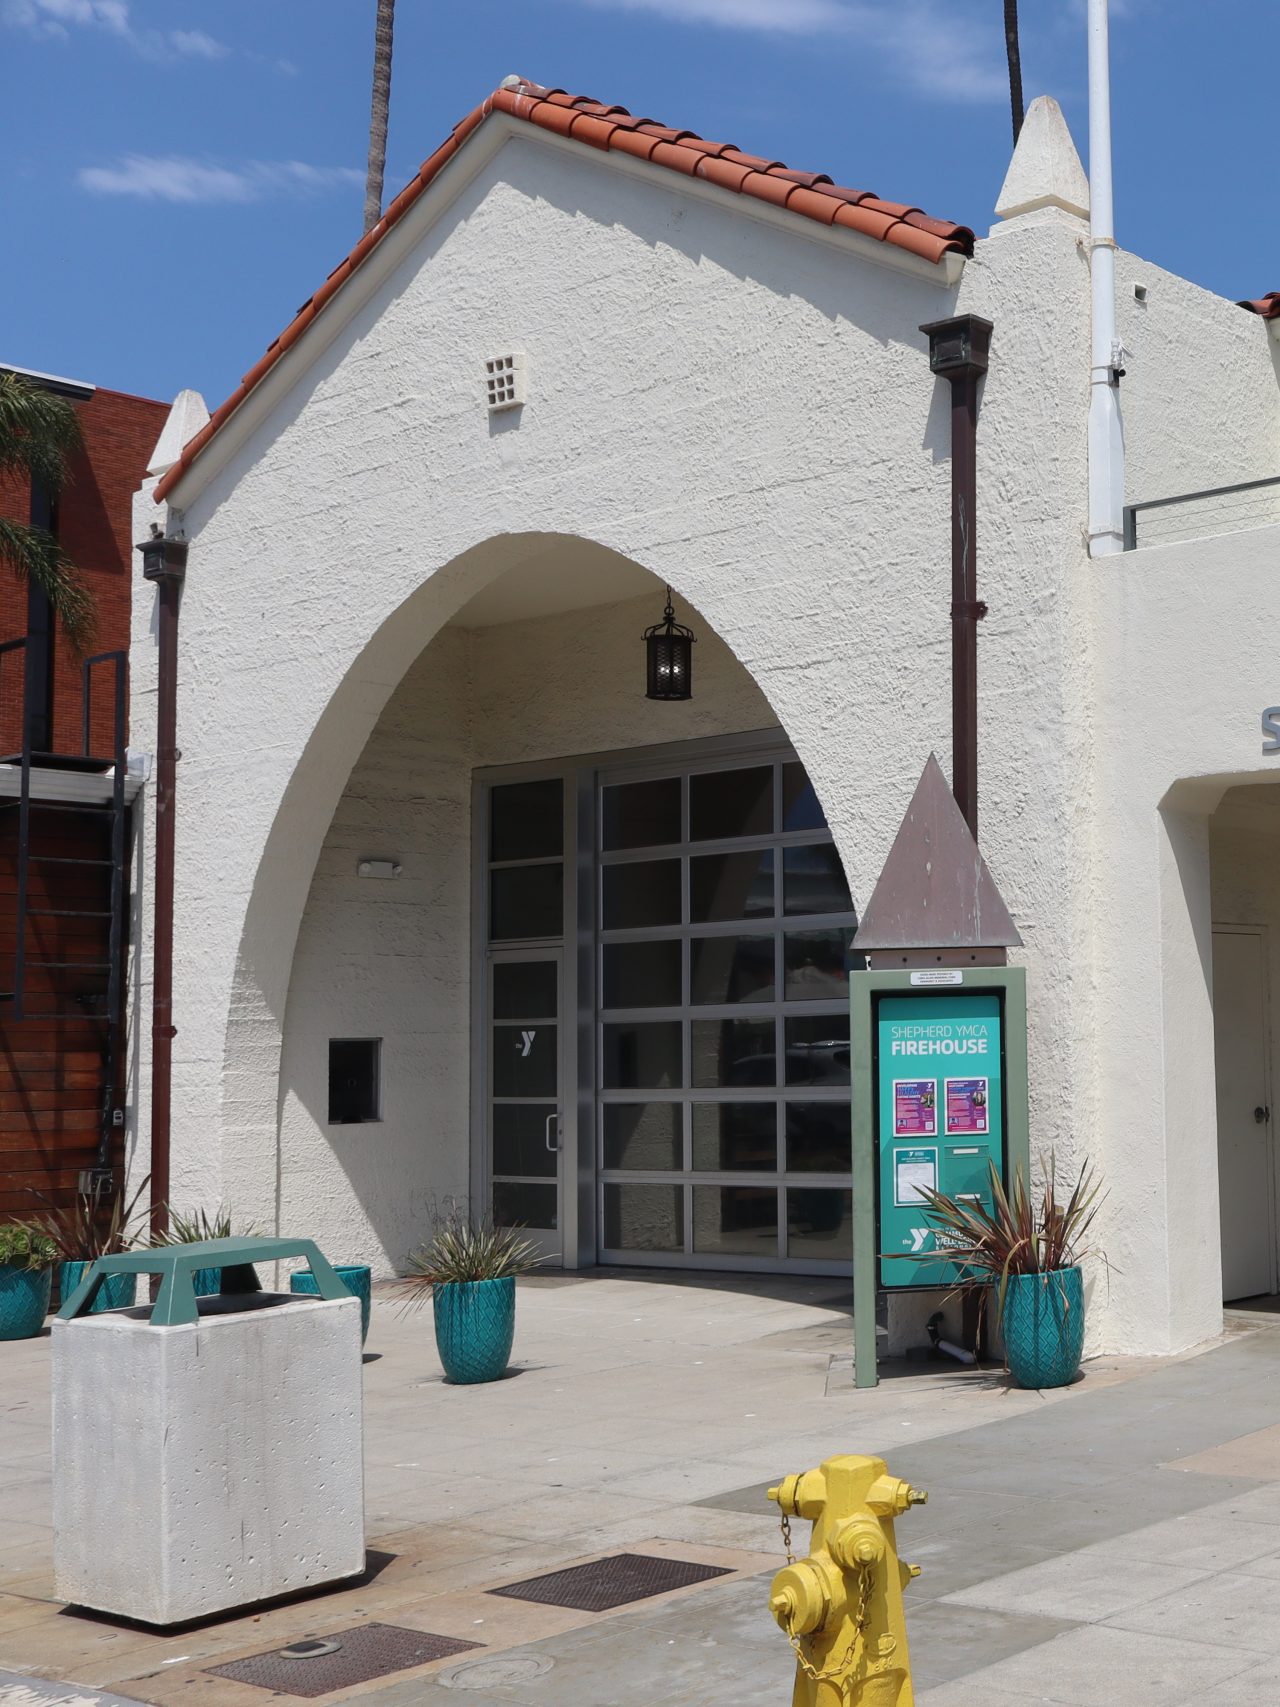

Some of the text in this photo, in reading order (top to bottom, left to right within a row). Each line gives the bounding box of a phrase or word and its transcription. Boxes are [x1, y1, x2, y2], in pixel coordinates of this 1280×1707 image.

[891, 1025, 989, 1039] SHEPHERD YMCA
[891, 1039, 988, 1056] FIREHOUSE
